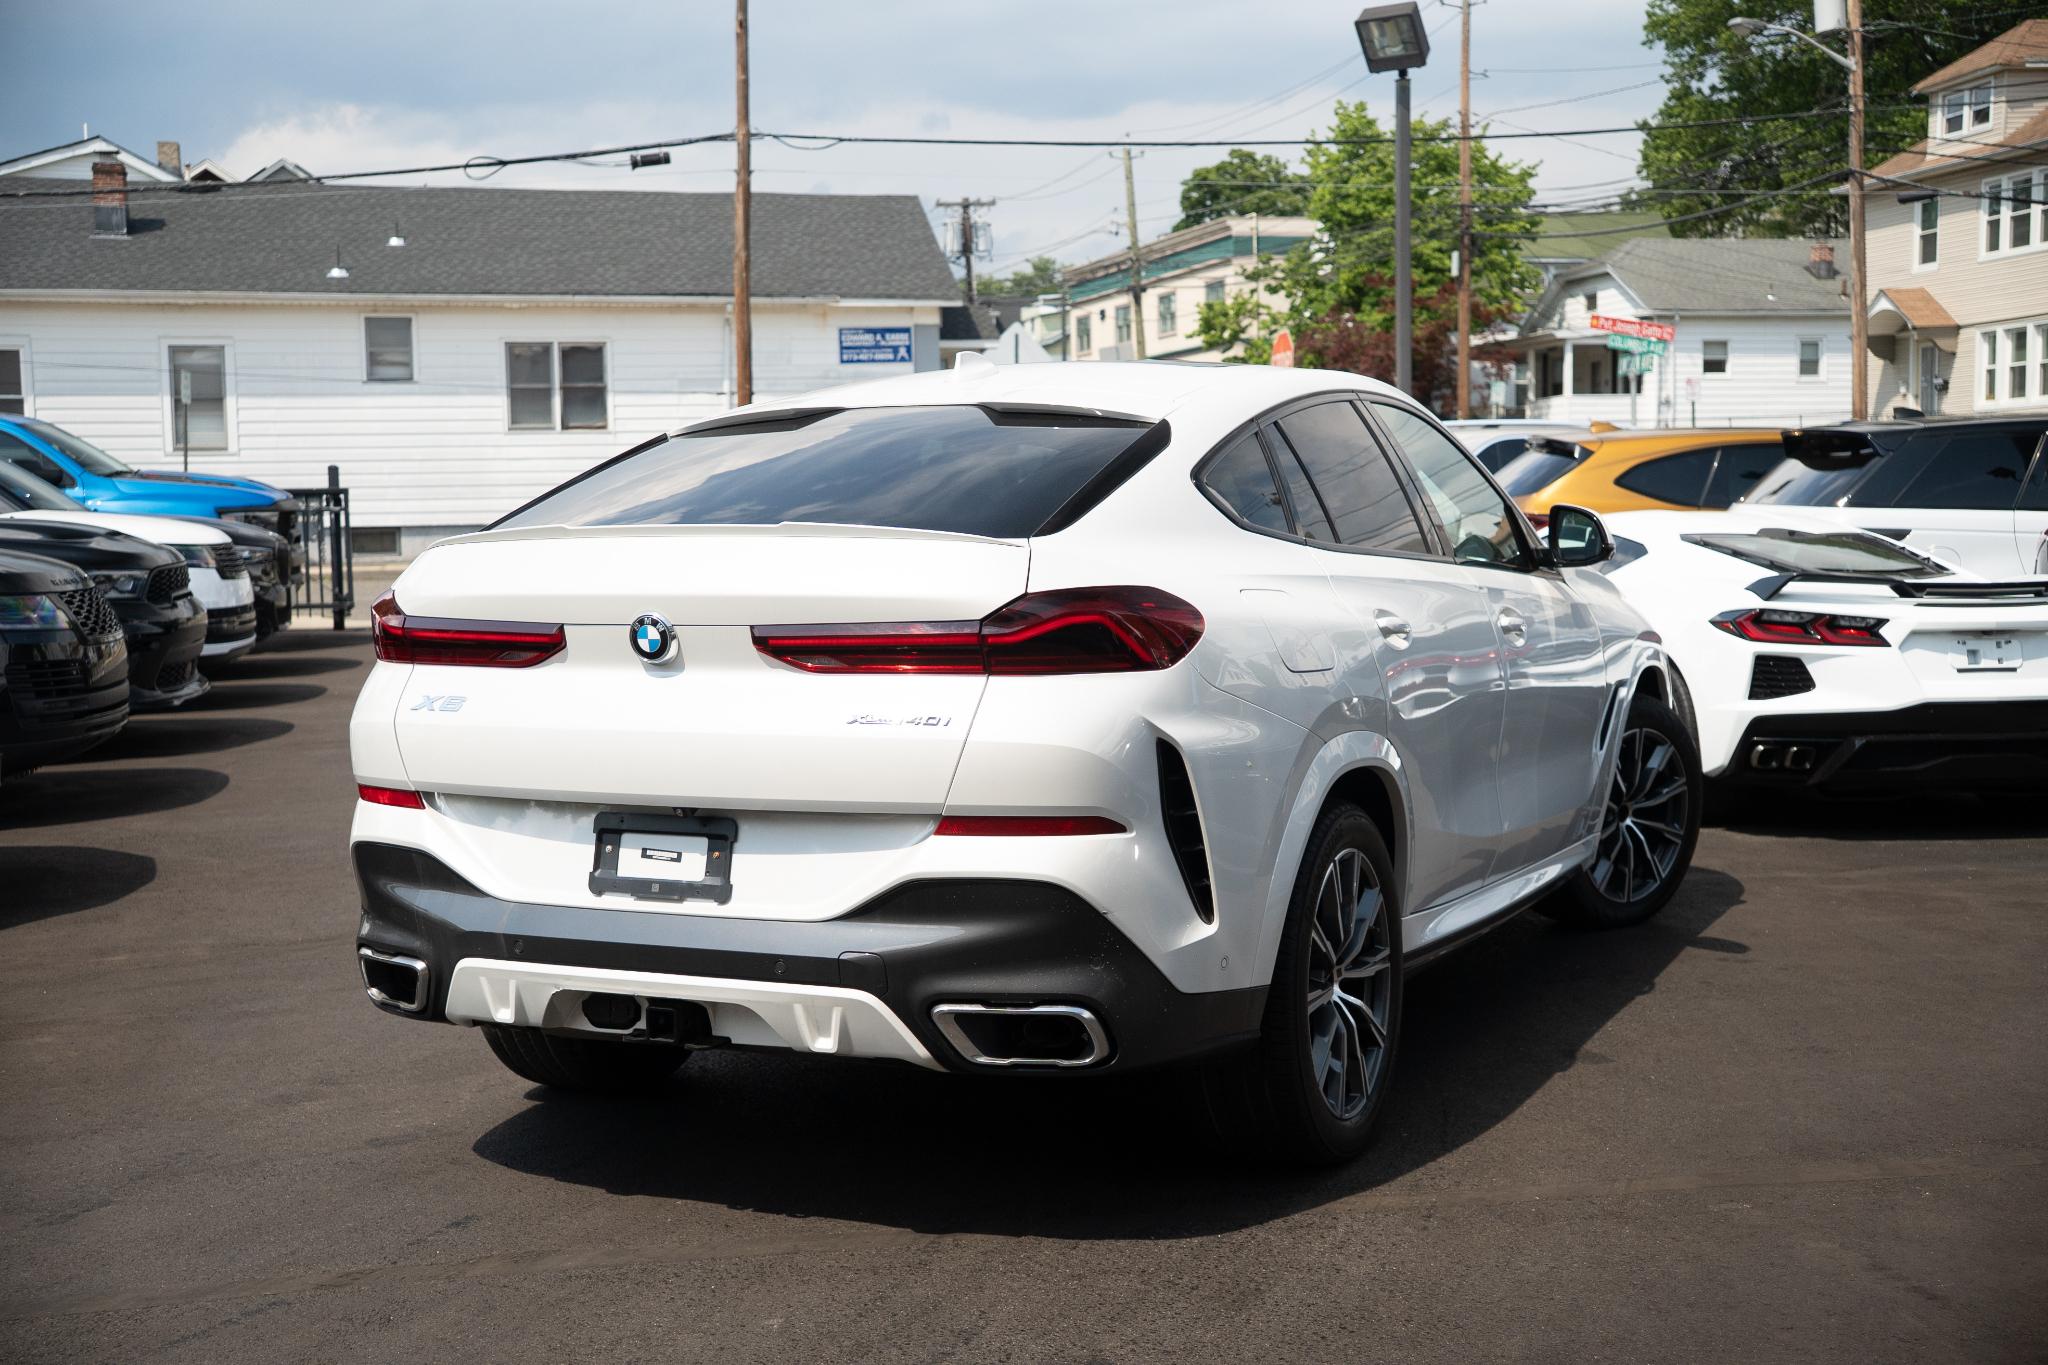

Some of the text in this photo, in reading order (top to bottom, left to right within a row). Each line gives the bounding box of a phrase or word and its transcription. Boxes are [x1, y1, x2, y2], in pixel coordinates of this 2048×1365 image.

[1610, 335, 1648, 352] COLUMBUS
[633, 617, 666, 632] BMW
[410, 695, 467, 712] X6
